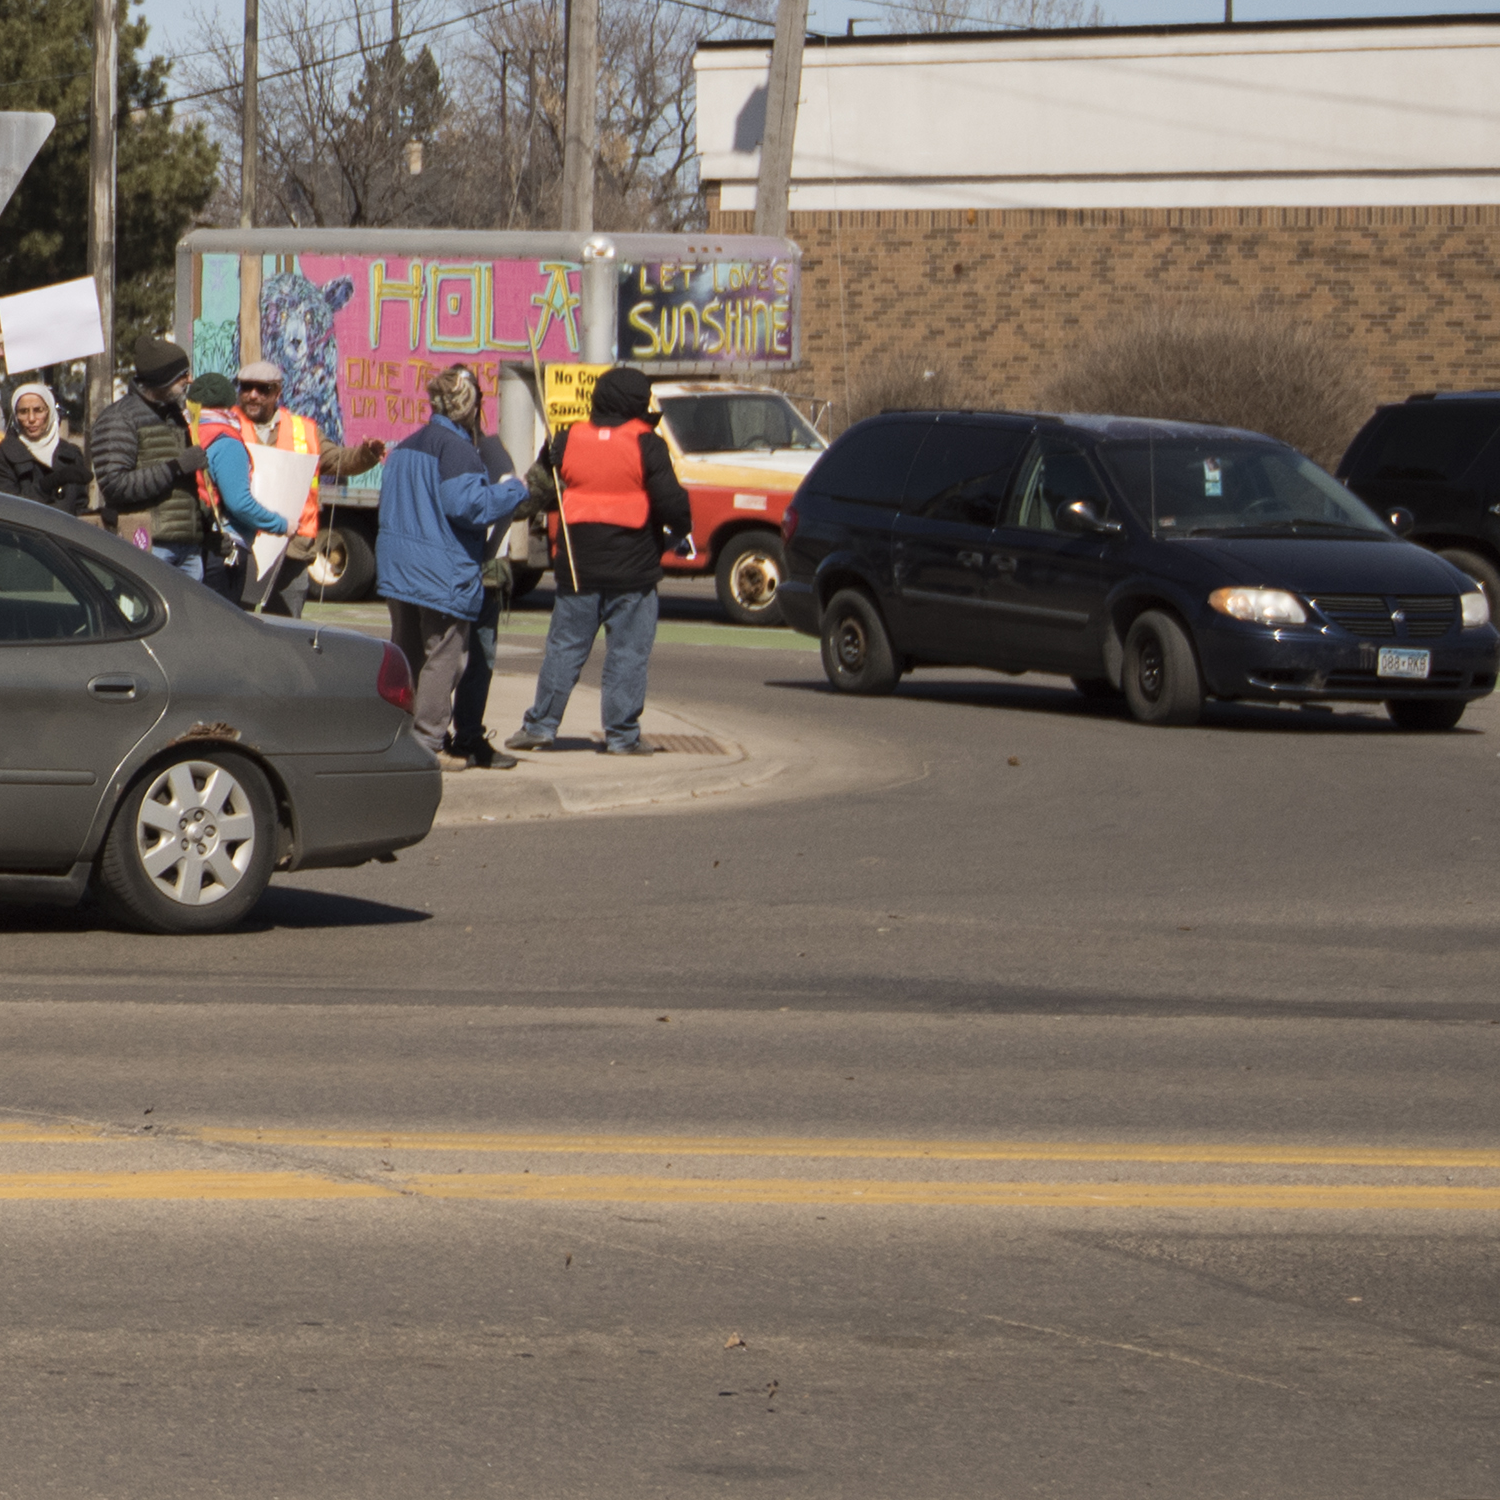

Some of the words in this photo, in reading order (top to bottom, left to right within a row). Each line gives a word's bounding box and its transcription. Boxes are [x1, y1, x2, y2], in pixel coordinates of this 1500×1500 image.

[639, 264, 695, 295] LET
[369, 259, 581, 353] HOLA
[346, 356, 402, 393] QUE
[555, 370, 573, 385] No
[575, 387, 592, 400] No
[386, 395, 430, 425] BUE
[549, 402, 591, 417] Sanct
